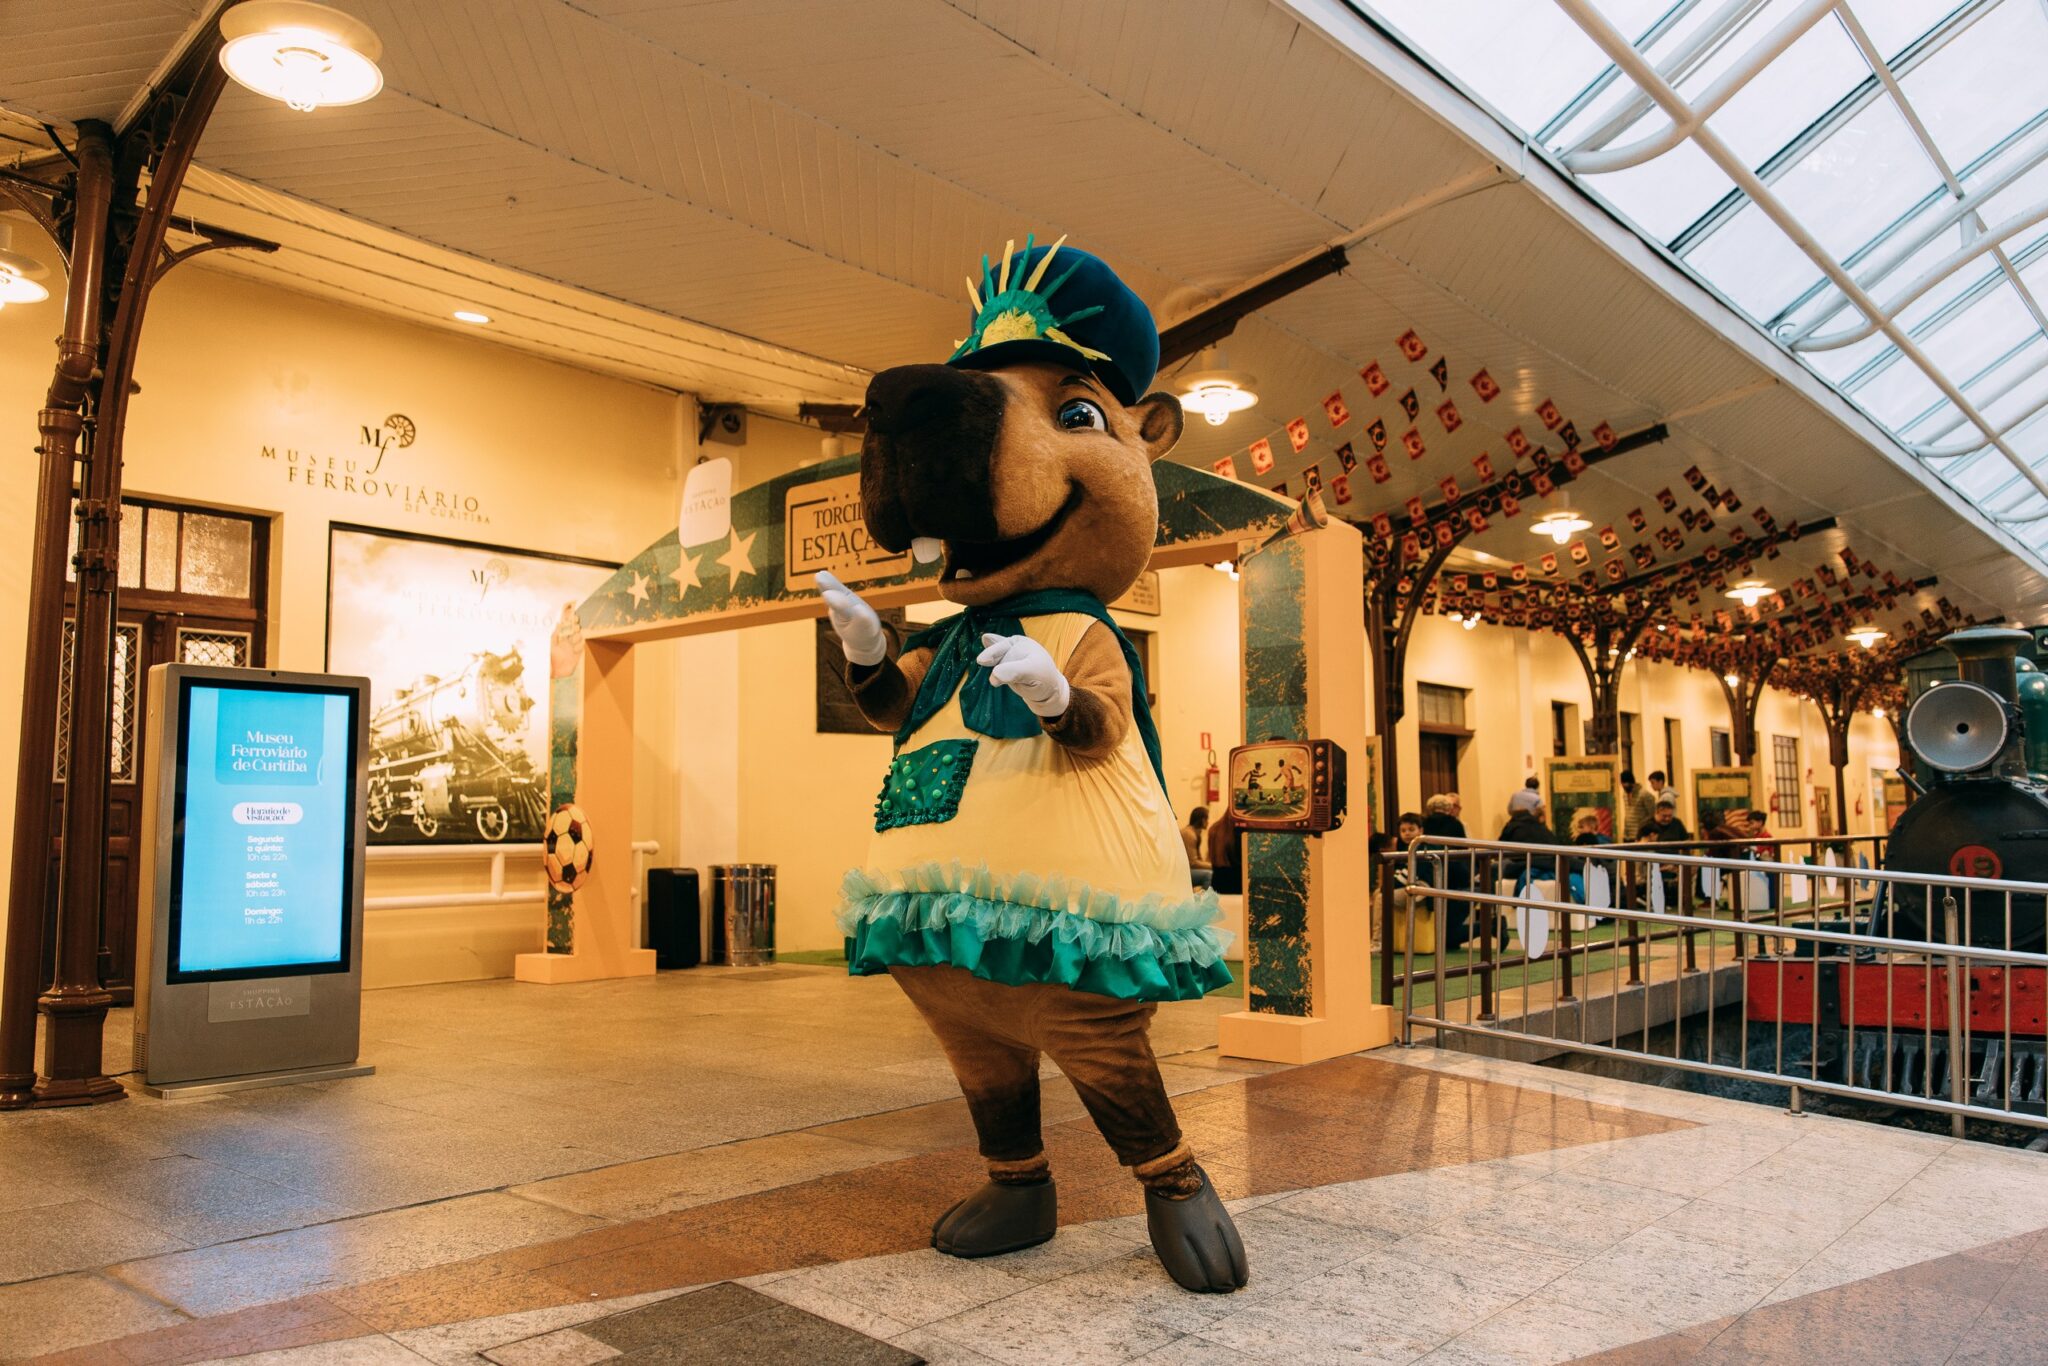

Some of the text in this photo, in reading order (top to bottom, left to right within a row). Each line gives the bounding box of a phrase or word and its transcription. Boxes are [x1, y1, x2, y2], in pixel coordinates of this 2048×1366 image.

[261, 445, 356, 473] MUSEU
[288, 466, 478, 512] FERROVIÁRIO
[813, 502, 863, 529] TORCI
[801, 527, 879, 561] ESTAÇA
[246, 730, 293, 744] Museu
[231, 744, 307, 759] Ferroviário
[232, 758, 307, 772] de Curitiba
[247, 835, 285, 845] Segunda
[272, 852, 288, 861] 22h
[246, 871, 270, 880] Sexta
